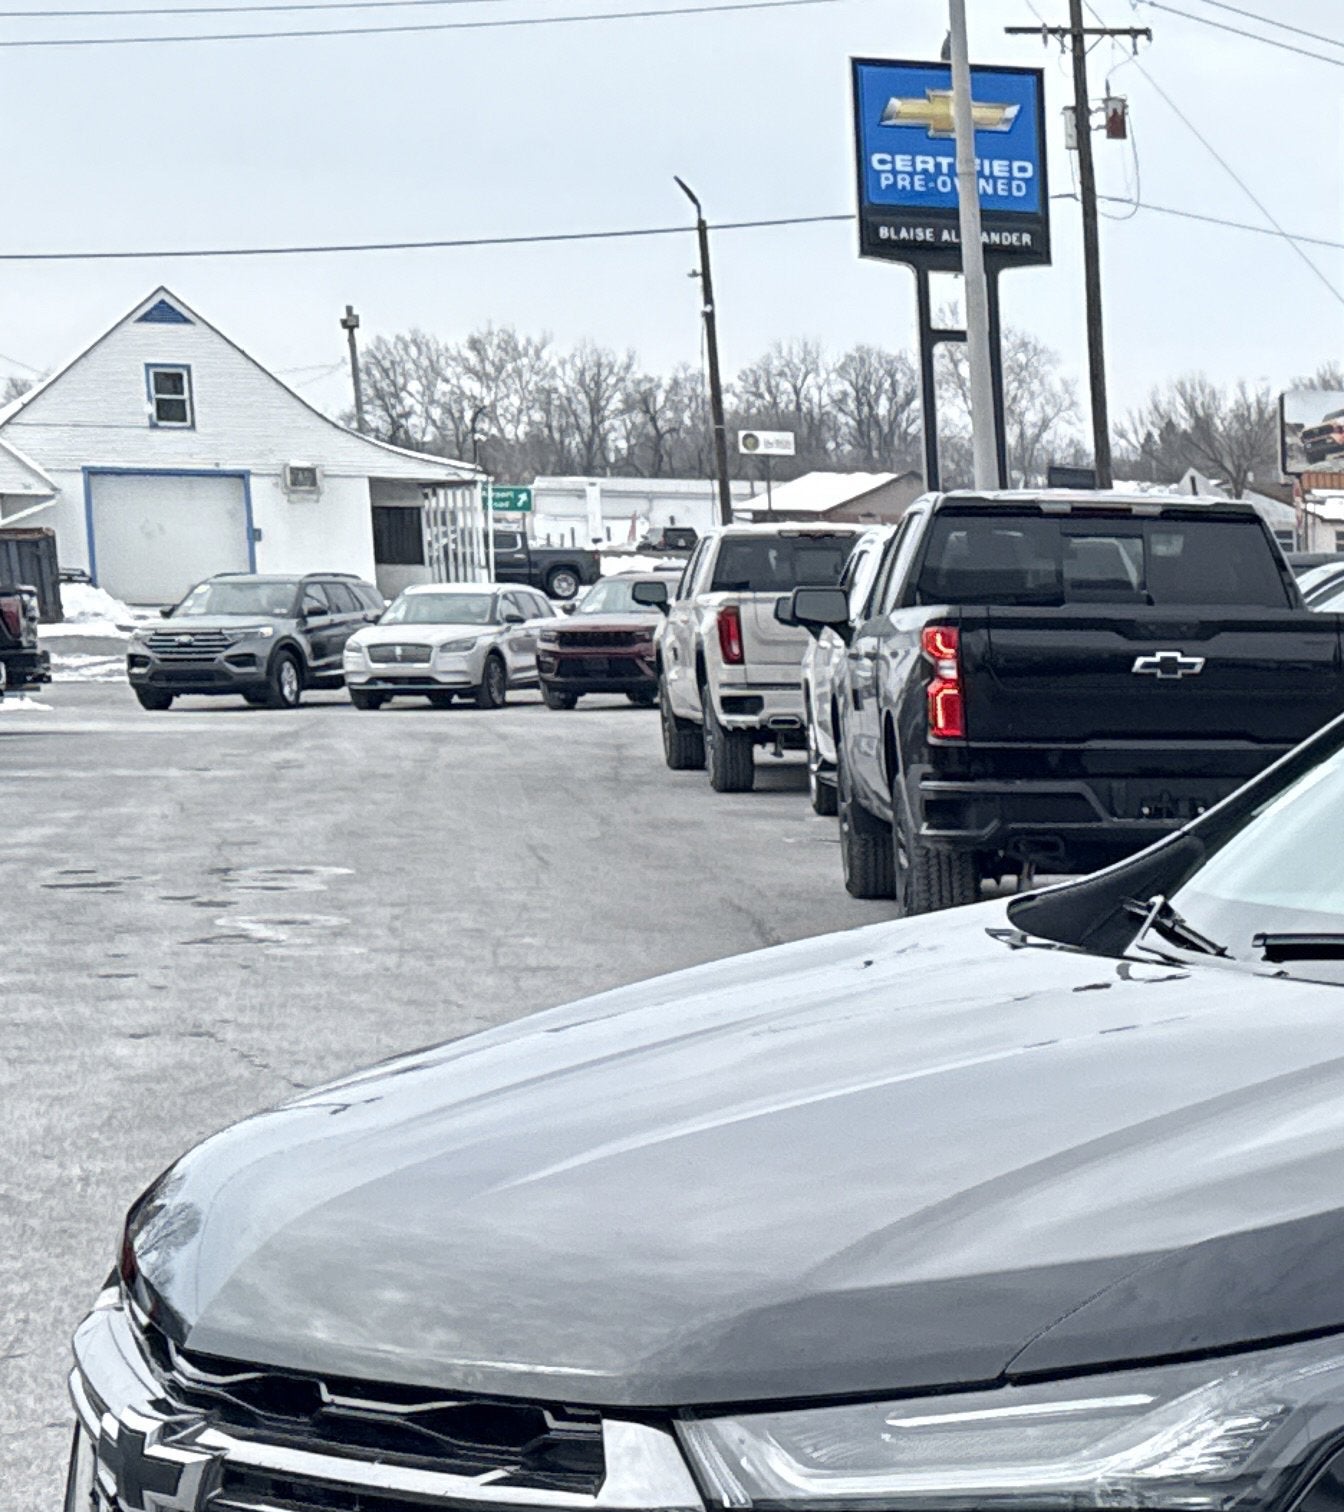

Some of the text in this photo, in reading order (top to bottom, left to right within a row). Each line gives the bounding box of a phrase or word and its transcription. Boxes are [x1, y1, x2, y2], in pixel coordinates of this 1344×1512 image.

[871, 153, 1034, 178] CERTIED
[879, 226, 1031, 246] BLAISE ALANDER
